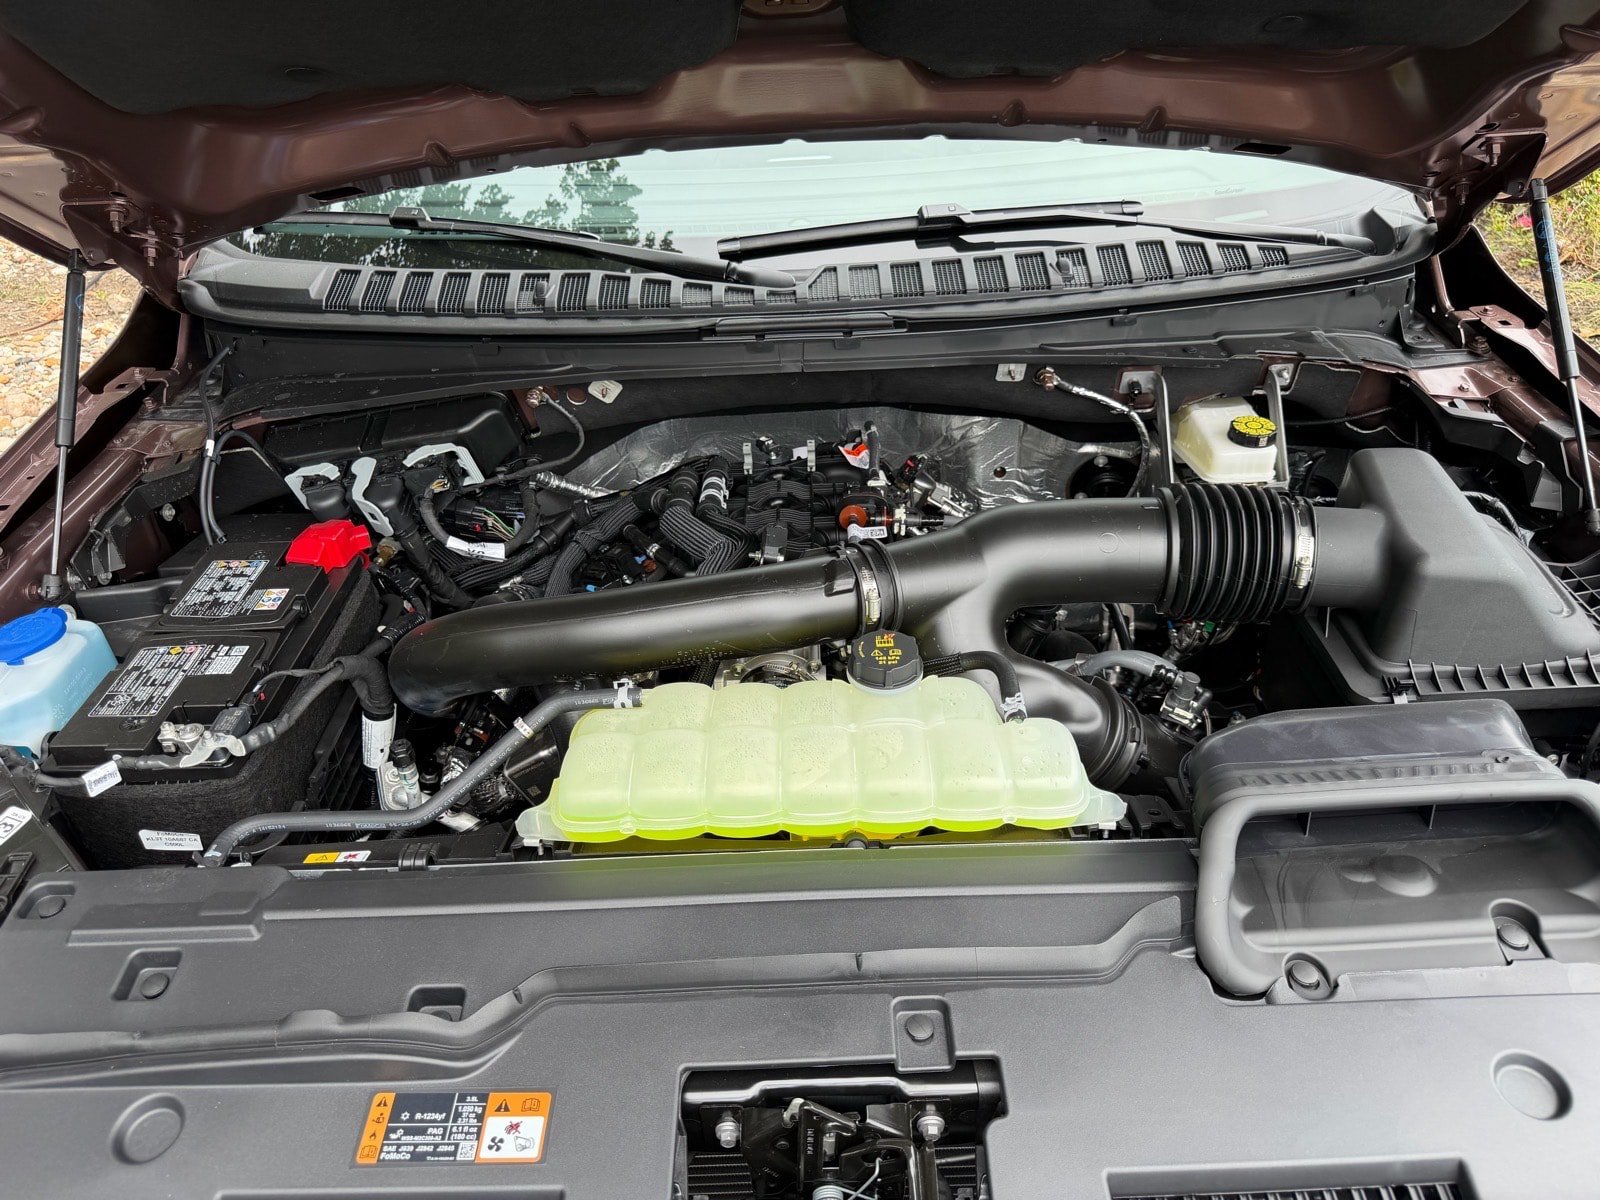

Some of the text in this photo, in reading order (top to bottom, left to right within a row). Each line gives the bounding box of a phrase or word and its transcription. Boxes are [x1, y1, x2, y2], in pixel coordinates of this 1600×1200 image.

[414, 1112, 447, 1121] R-1234yf
[427, 1127, 444, 1135] PAG
[380, 1152, 411, 1160] FoMoCo
